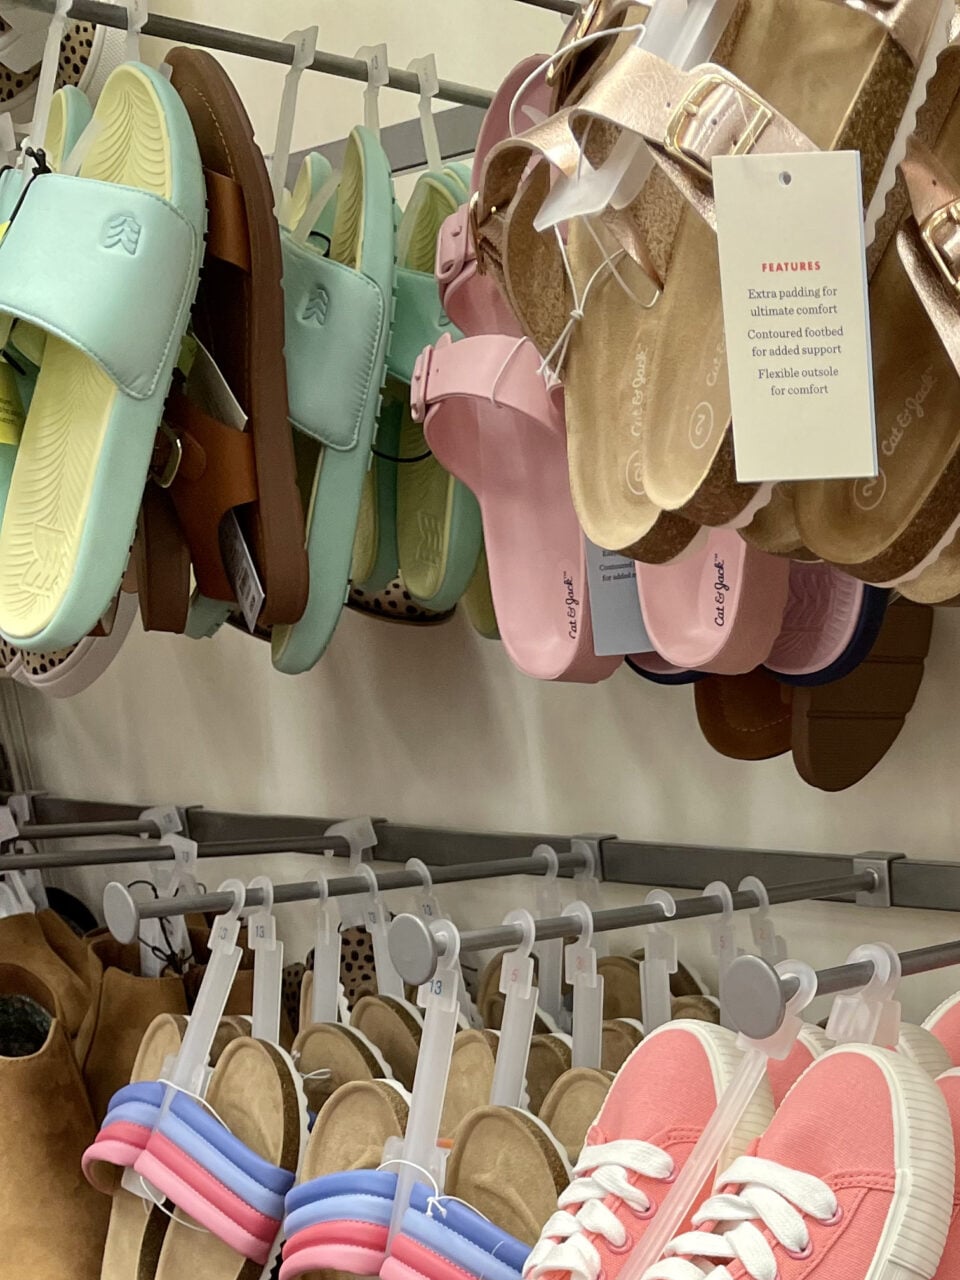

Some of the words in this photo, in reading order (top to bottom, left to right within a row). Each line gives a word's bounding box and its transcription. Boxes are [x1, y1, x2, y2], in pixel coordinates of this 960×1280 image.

[761, 260, 821, 272] FEATURES
[748, 288, 777, 299] Extra
[779, 286, 820, 300] padding
[822, 286, 838, 297] for
[750, 305, 795, 317] ultimate
[796, 304, 838, 315] comfort
[747, 327, 802, 340] Contoured
[804, 326, 844, 338] footbed
[752, 347, 767, 357] for
[769, 344, 800, 356] added
[801, 344, 842, 357] support
[758, 367, 800, 379] Flexible
[801, 366, 839, 378] outsole
[770, 385, 786, 396] for
[787, 384, 829, 395] comfort
[695, 414, 706, 436] 2
[714, 592, 725, 604] &
[714, 604, 725, 627] Cat
[255, 925, 265, 938] 13
[511, 968, 519, 983] 5
[429, 979, 442, 996] 13
